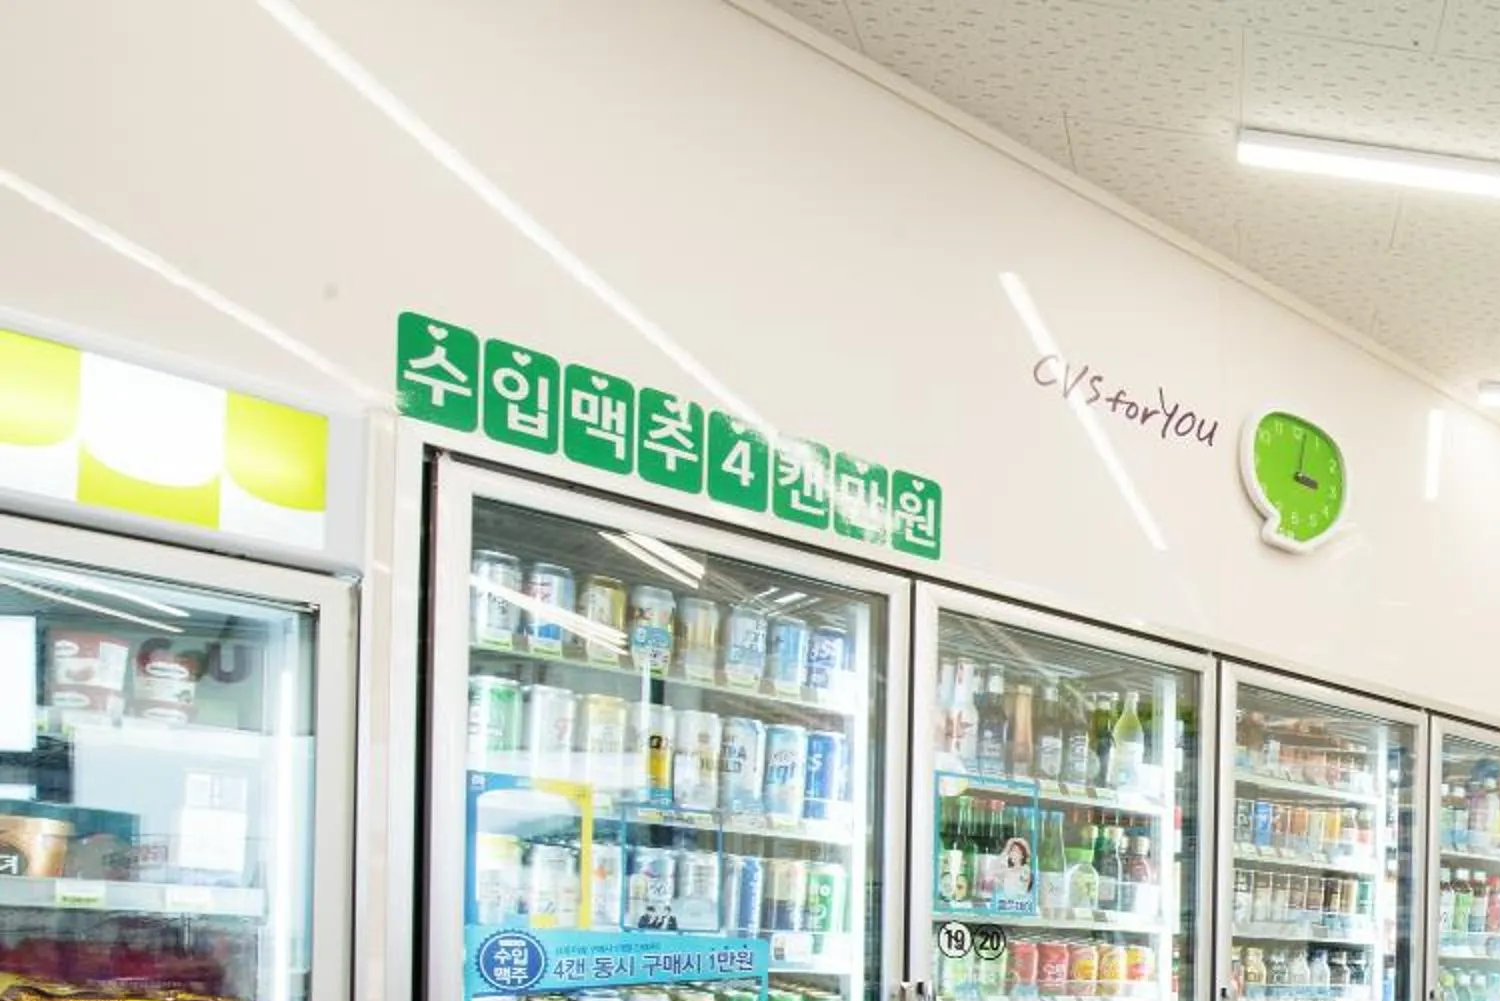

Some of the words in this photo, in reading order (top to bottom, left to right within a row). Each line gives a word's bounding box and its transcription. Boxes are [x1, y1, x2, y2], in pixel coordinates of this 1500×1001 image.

[943, 929, 966, 951] 19
[979, 930, 1000, 951] 20
[552, 957, 586, 981] 4캔
[592, 955, 635, 979] 동시
[642, 951, 702, 977] 구매시
